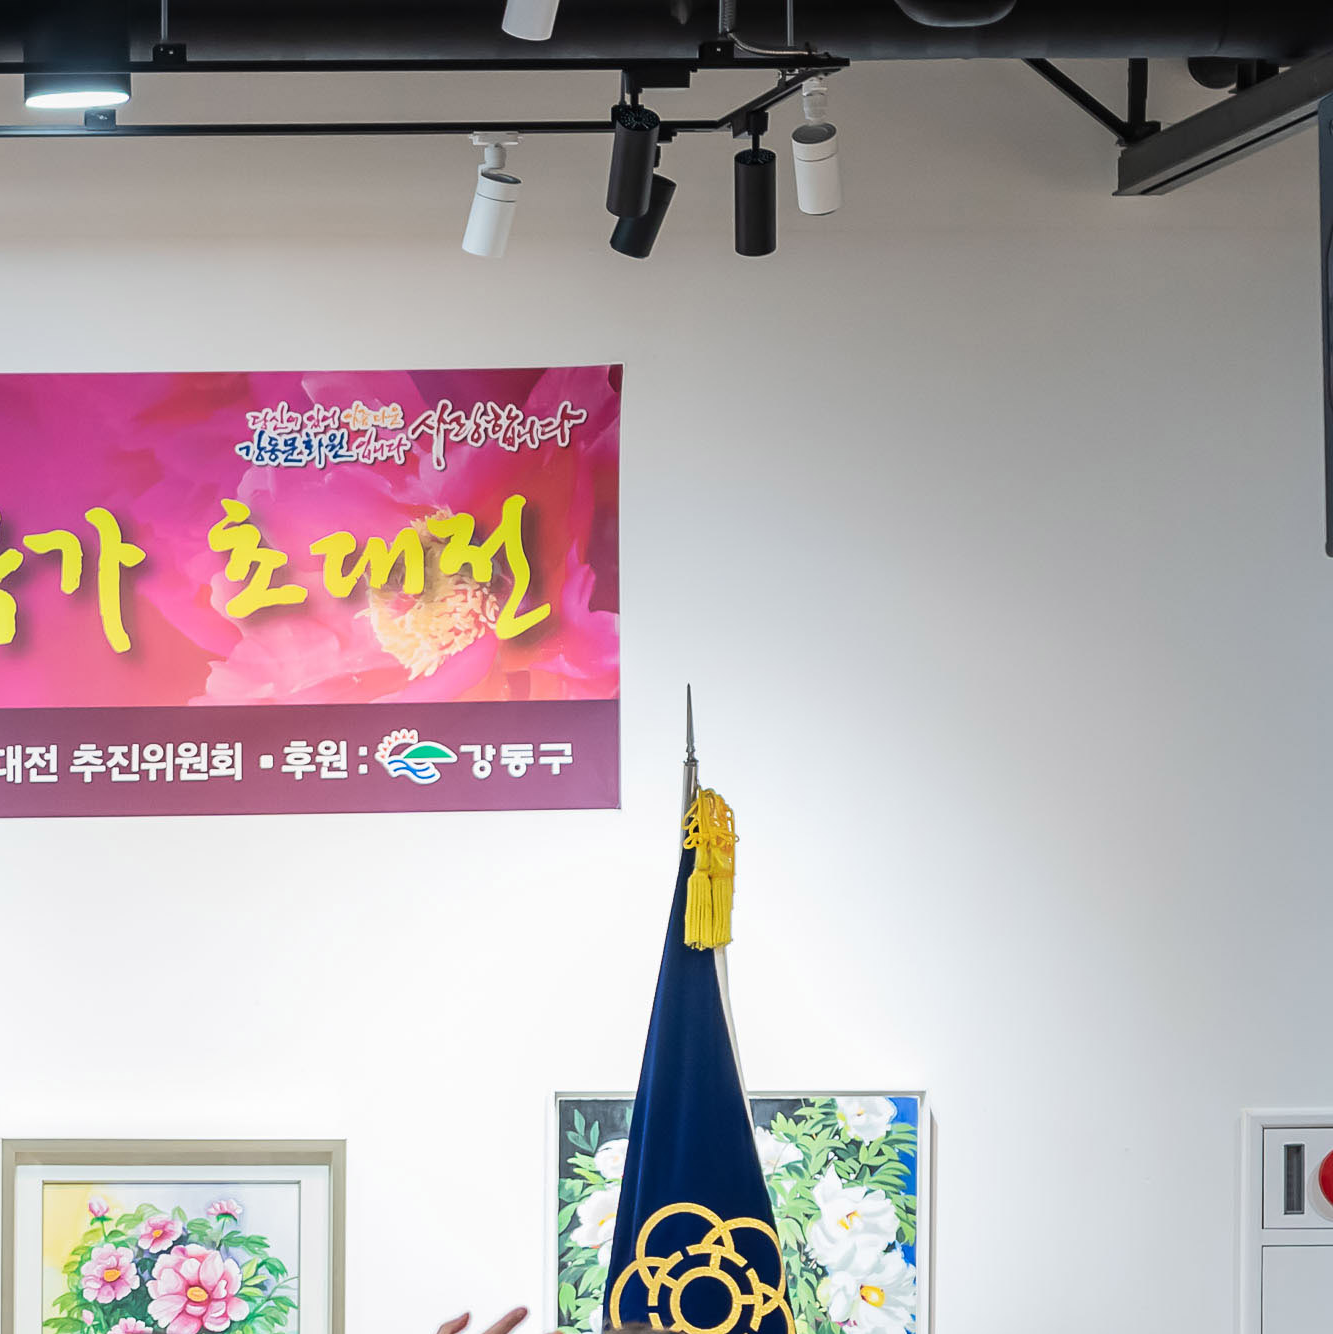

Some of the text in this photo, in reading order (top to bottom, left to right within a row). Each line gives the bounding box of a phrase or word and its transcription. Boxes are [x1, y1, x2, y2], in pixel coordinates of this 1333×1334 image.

[248, 402, 404, 432] 당신이 있어 아름다운
[411, 401, 585, 468] 사랑합니다
[207, 494, 552, 640] 초대전
[69, 742, 243, 784] 추진위원회
[460, 743, 574, 780] 강동구
